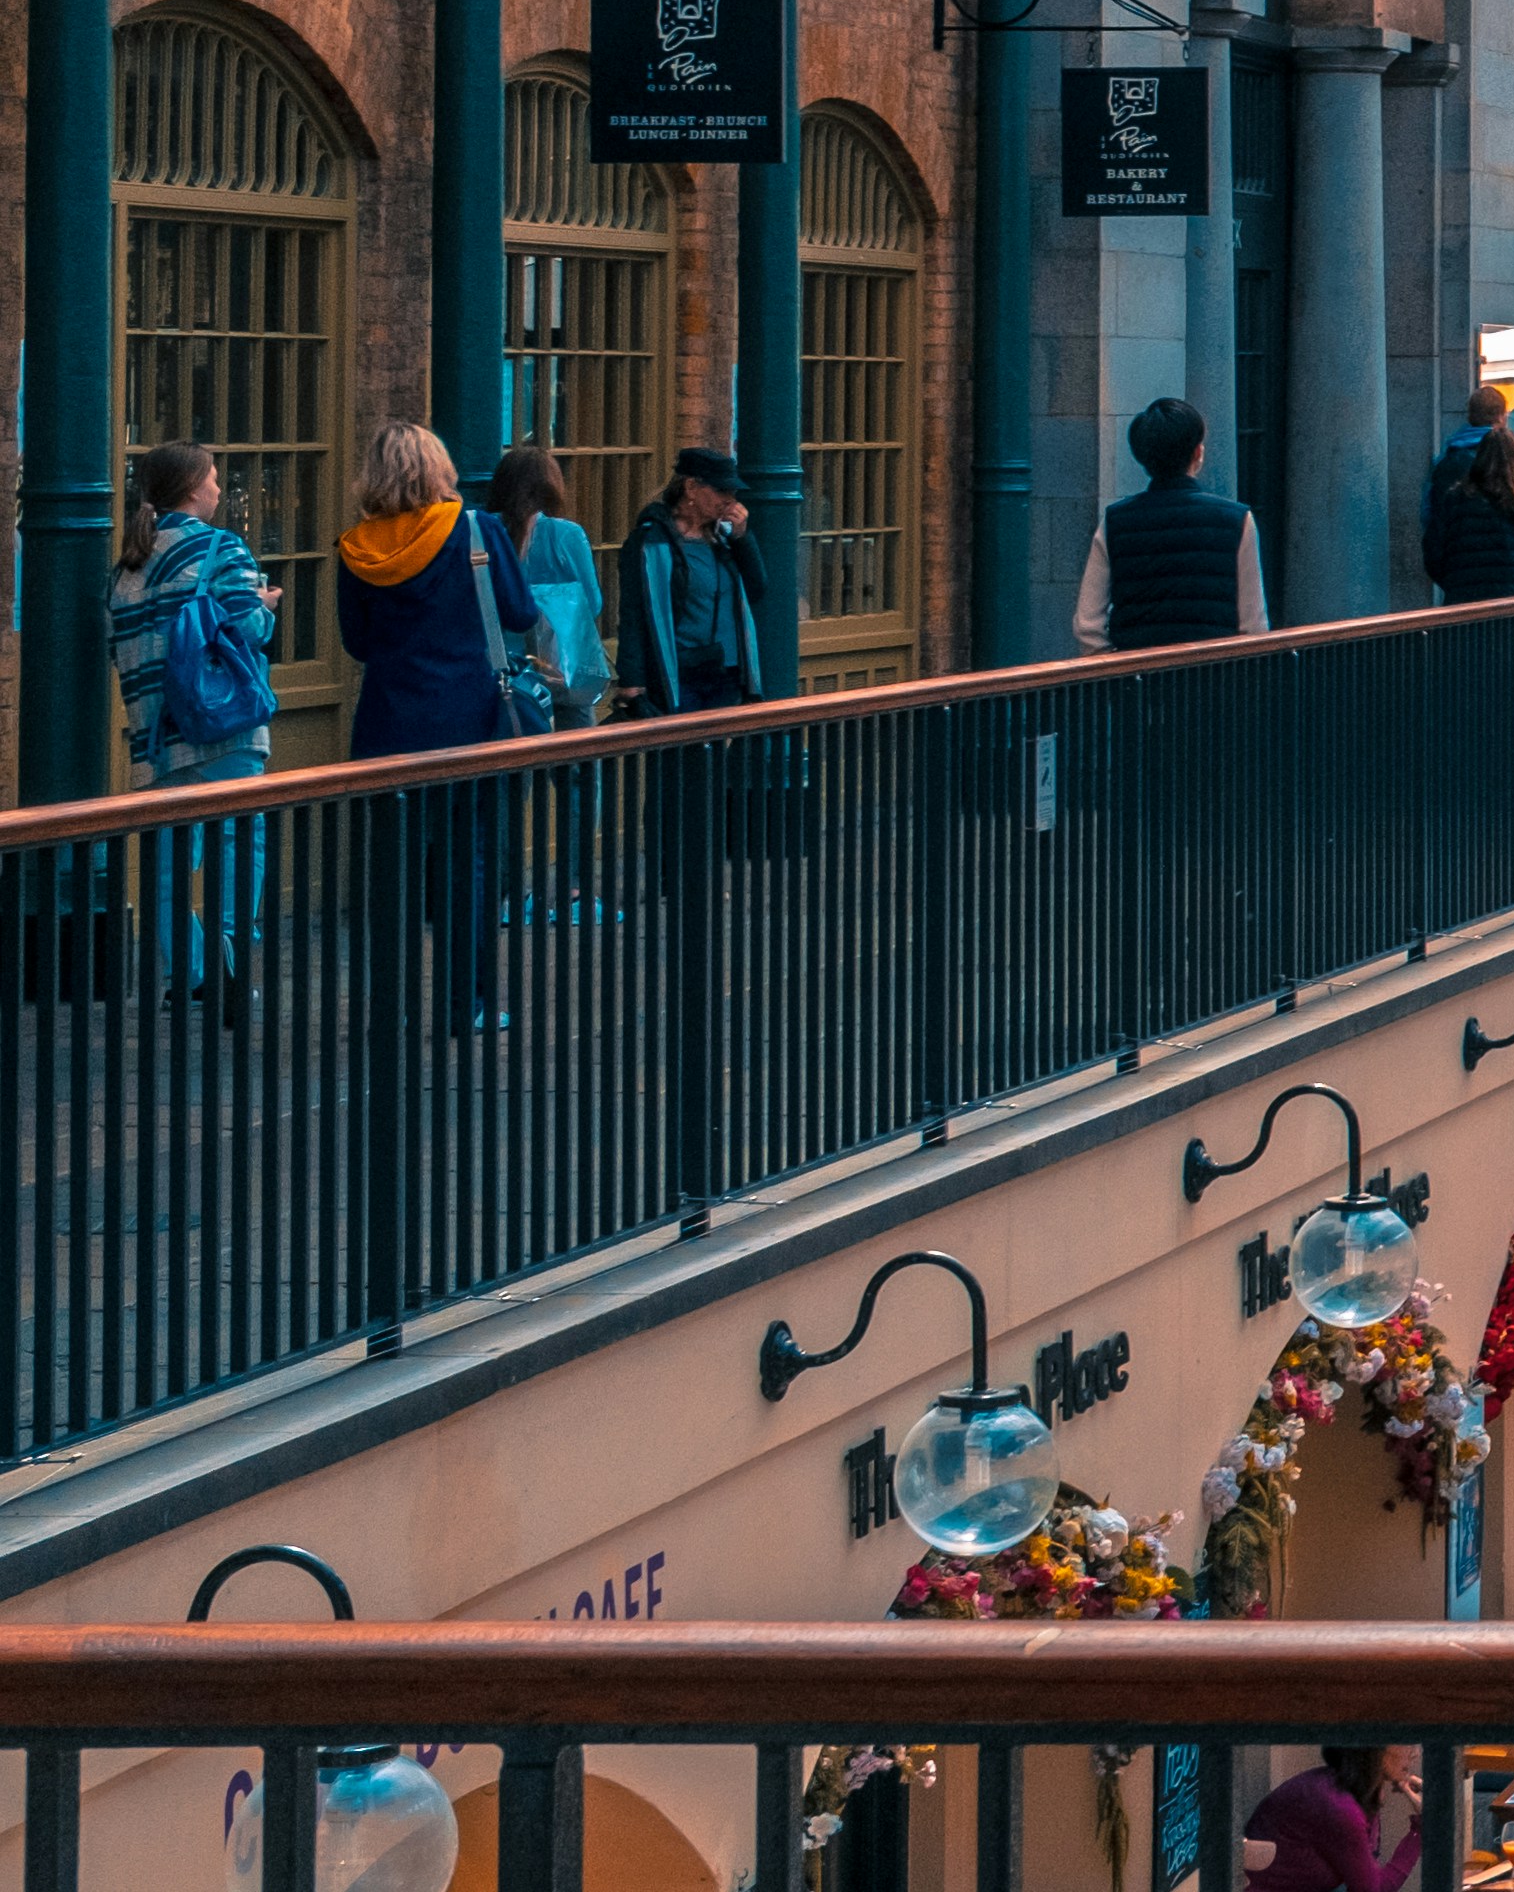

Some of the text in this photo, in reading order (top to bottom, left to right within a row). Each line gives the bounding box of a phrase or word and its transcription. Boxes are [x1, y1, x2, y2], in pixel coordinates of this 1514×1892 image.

[657, 52, 718, 84] Pain
[1105, 168, 1168, 179] BAKERY
[1086, 193, 1188, 205] RESTAURANT
